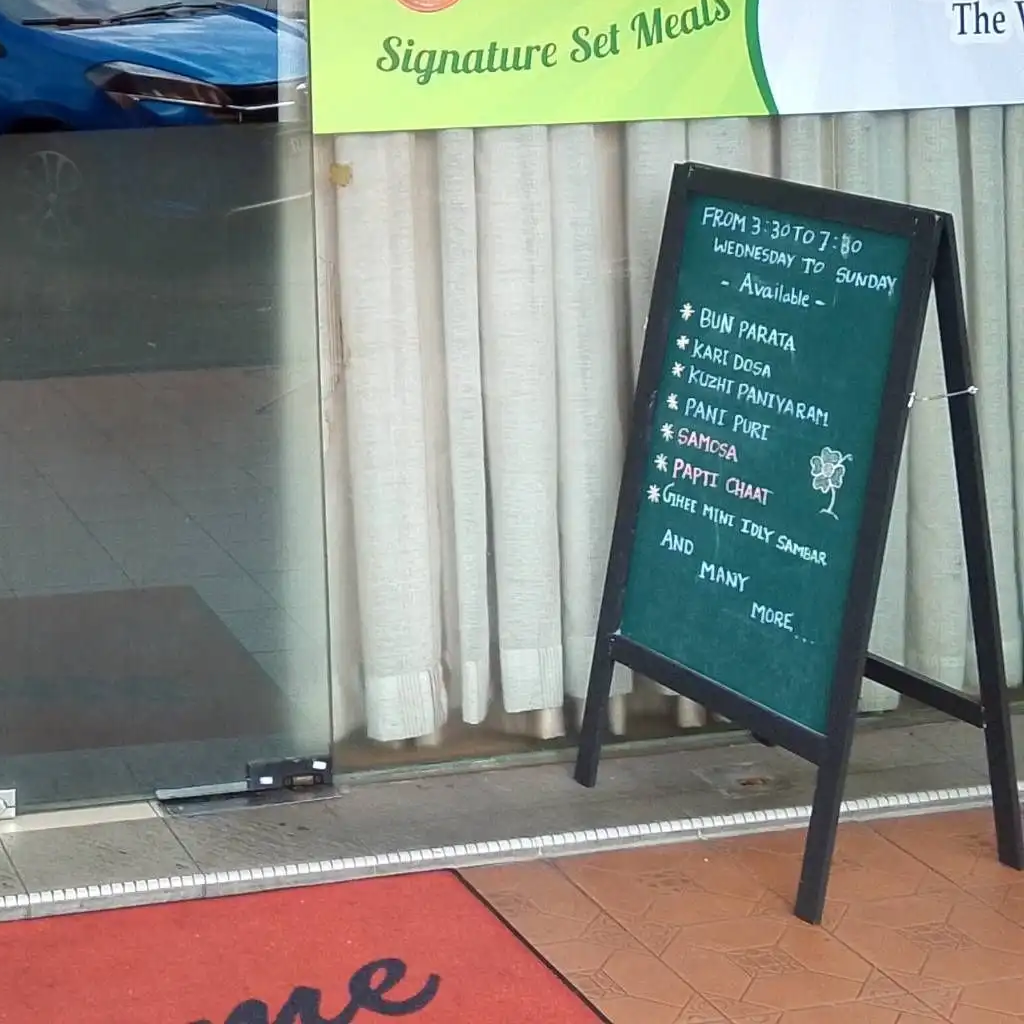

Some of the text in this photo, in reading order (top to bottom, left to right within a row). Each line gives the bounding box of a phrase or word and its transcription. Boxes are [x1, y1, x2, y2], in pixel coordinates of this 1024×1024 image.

[952, 0, 1006, 35] The
[376, 35, 557, 85] Signature
[570, 23, 620, 63] Set
[702, 206, 746, 233] FROM
[791, 225, 815, 245] TO
[714, 237, 897, 297] WEDNESDAY TO SUNDAY
[739, 272, 810, 308] Available
[699, 307, 797, 352] BUN PARATA
[690, 338, 772, 379] KARI DOSA
[687, 364, 829, 428] KUZHI PANIYARAM
[684, 397, 772, 441] PANI PURI
[677, 428, 739, 463] SAMOSA
[672, 458, 775, 506] PAPTI CHAAT
[660, 528, 695, 556] AND
[662, 482, 828, 567] GHEE MINI IDLY SAMBAR
[698, 560, 751, 593] MANY
